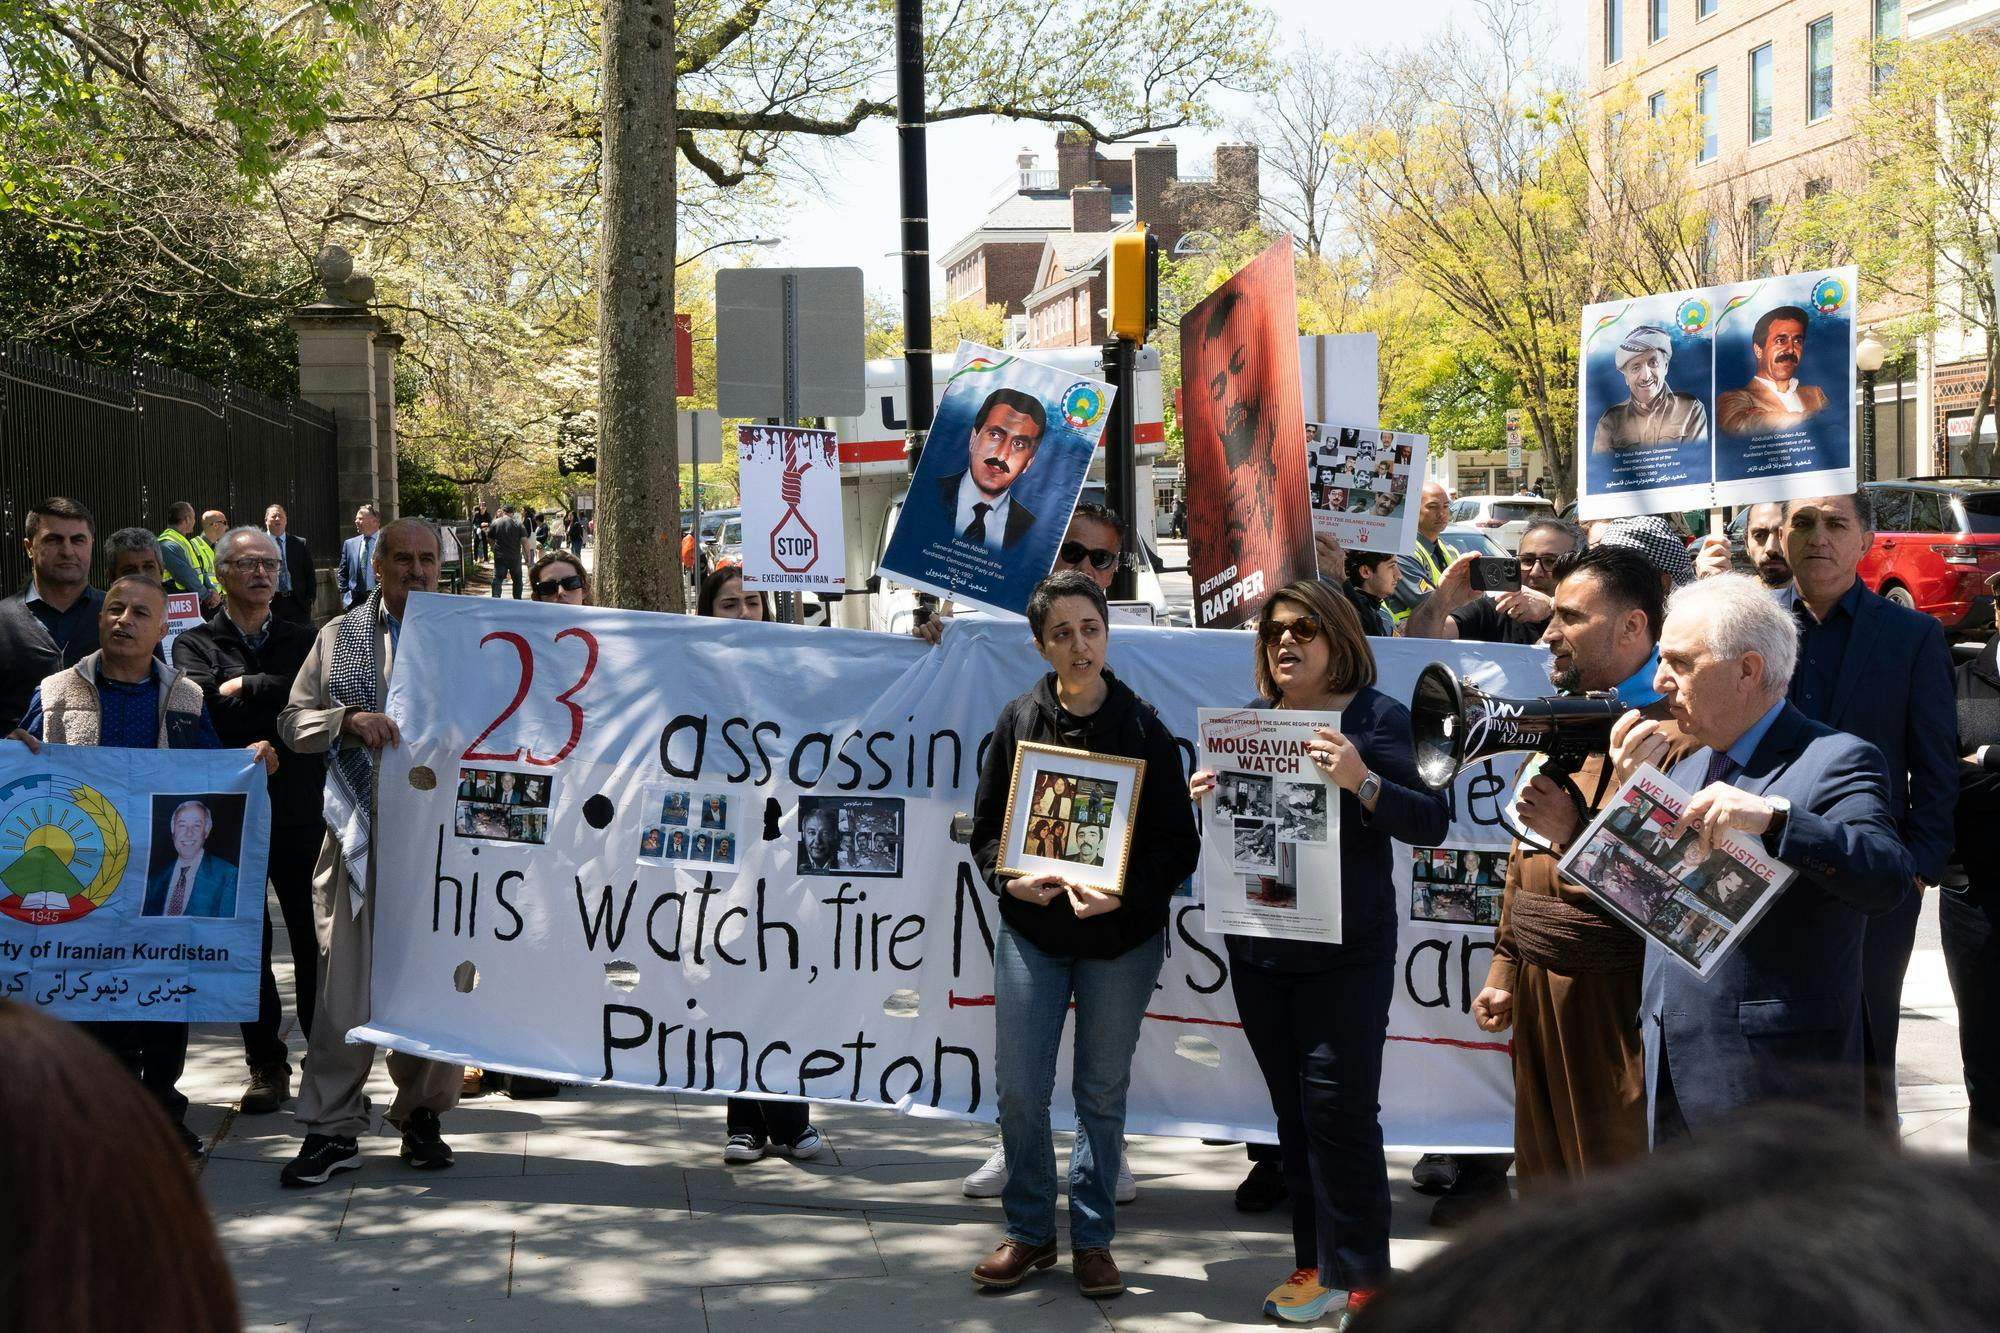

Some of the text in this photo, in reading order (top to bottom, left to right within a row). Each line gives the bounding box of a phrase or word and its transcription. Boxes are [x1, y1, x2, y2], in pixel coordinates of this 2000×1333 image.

[778, 537, 813, 556] STOP
[932, 543, 952, 551] General
[762, 573, 829, 584] EXECUTIONS IN IRAN
[1200, 564, 1238, 596] DETAINED
[168, 600, 192, 613] MES
[1202, 569, 1265, 624] RAPPER
[461, 627, 600, 767] 23
[1488, 717, 1519, 734] JIYAN
[1237, 755, 1300, 774] WATCH
[1639, 778, 1662, 799] WE
[1719, 838, 1775, 880] JUSTICE
[432, 824, 525, 942] his
[823, 881, 926, 973] fire
[30, 910, 60, 922] 1945
[30, 940, 52, 959] of
[56, 941, 126, 960] Iranian
[132, 943, 229, 961] Kurdistan
[600, 997, 980, 1114] Princeton
